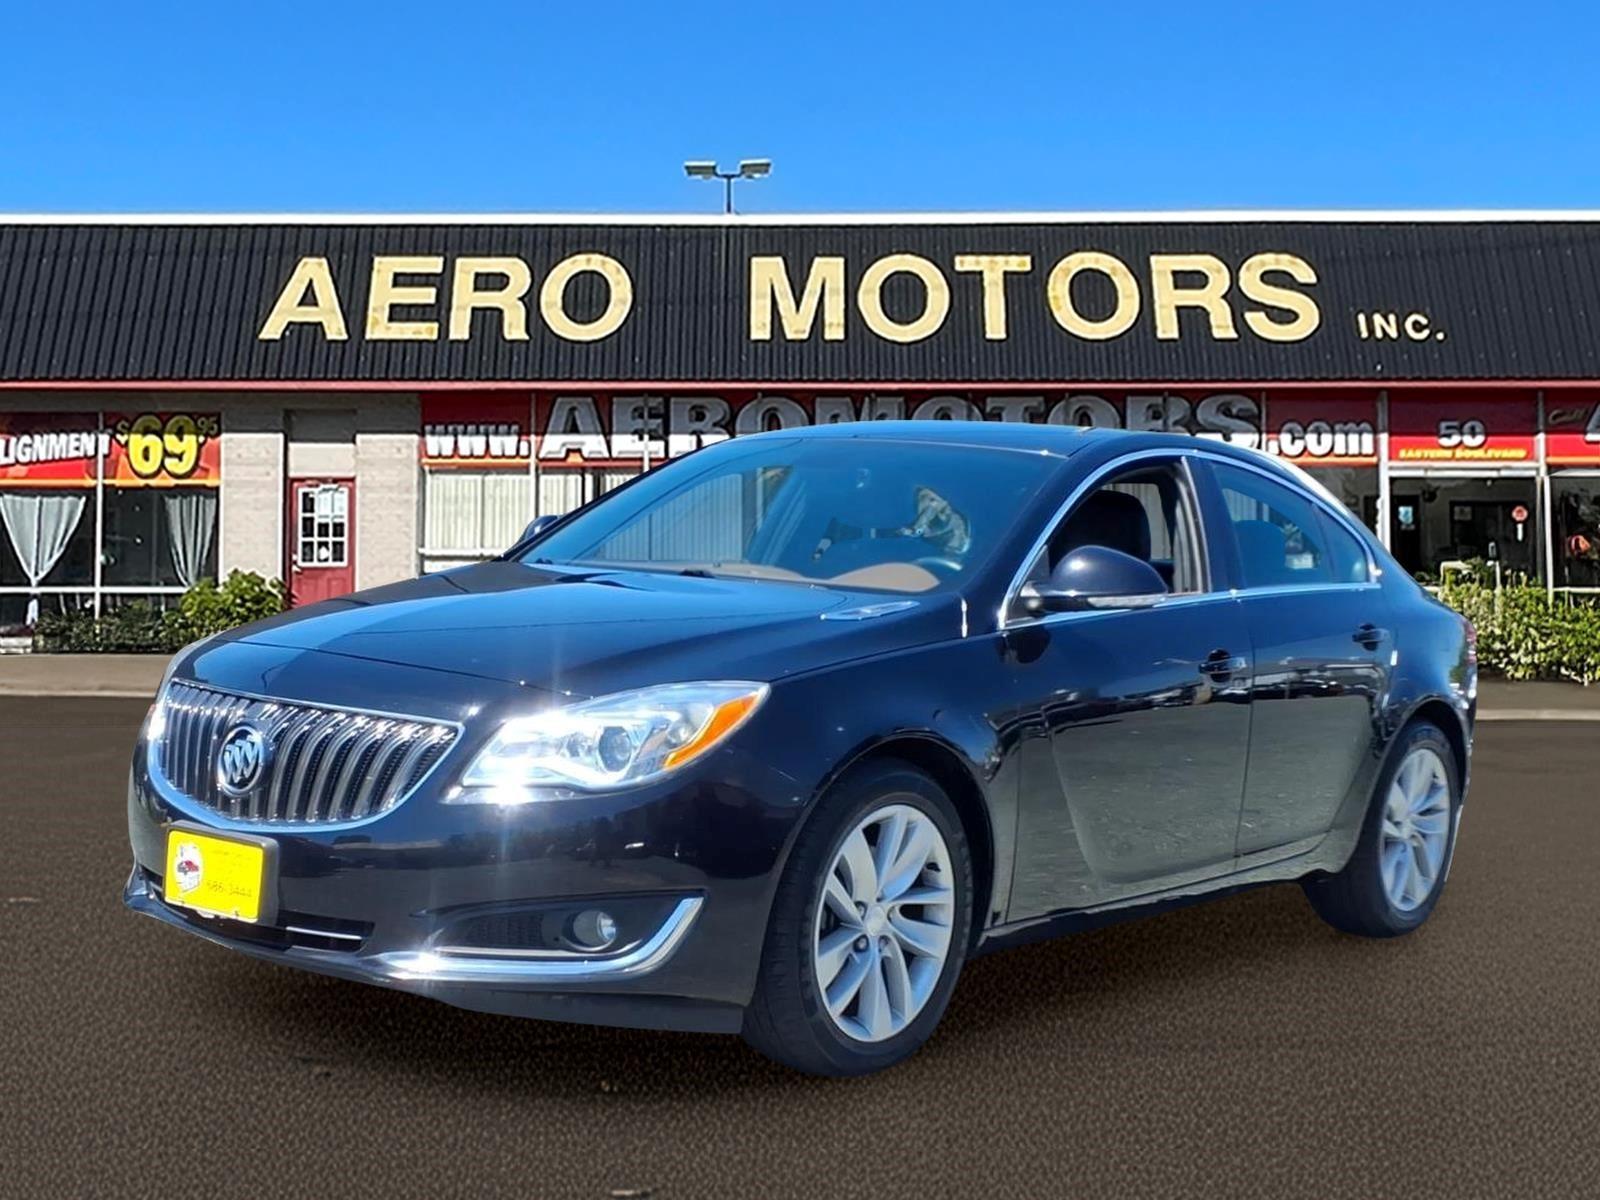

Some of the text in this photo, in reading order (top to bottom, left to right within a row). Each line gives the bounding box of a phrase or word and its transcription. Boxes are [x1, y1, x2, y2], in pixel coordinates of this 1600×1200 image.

[258, 251, 1446, 343] AERO MOTORS INC.
[1438, 420, 1486, 448] 50
